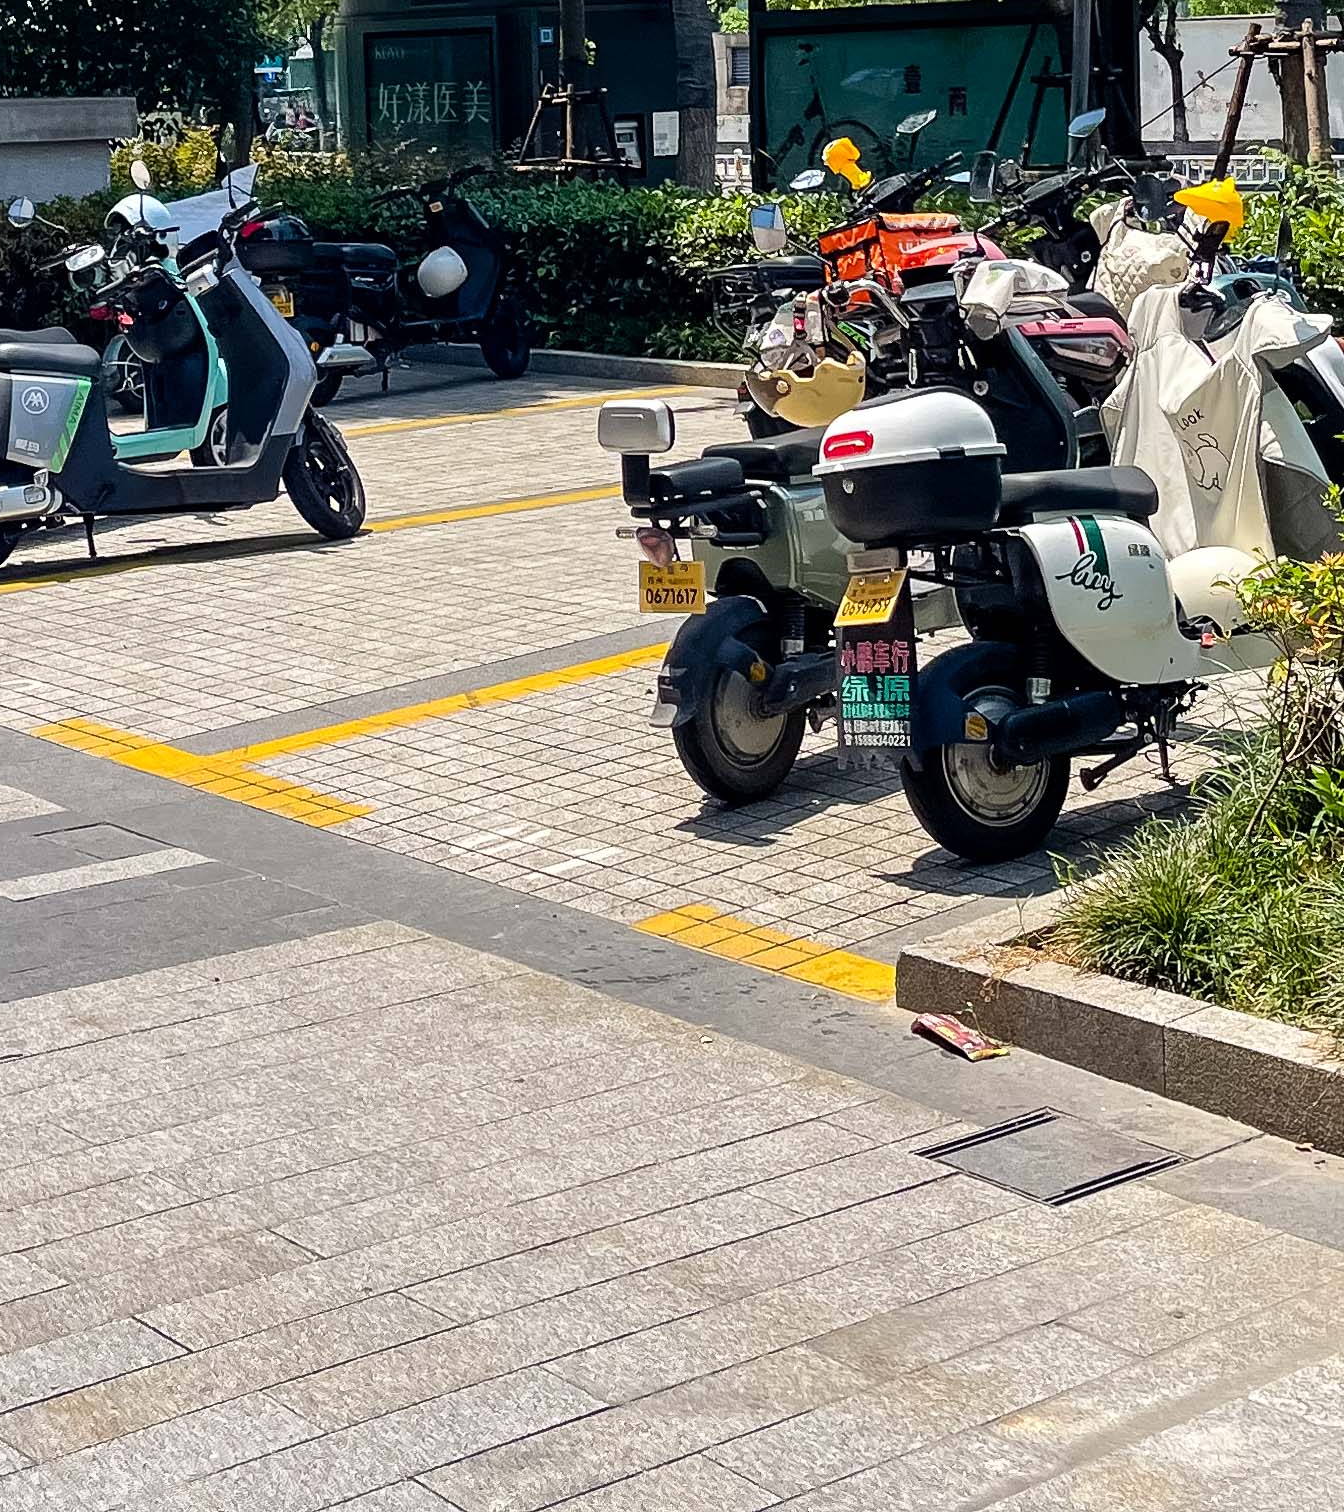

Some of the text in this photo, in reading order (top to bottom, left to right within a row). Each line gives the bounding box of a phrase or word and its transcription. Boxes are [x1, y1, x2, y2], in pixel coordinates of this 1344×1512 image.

[379, 80, 491, 125] 好漾医美
[1175, 408, 1205, 431] LOOK
[646, 588, 698, 605] 0671617
[841, 675, 910, 702] 绿源
